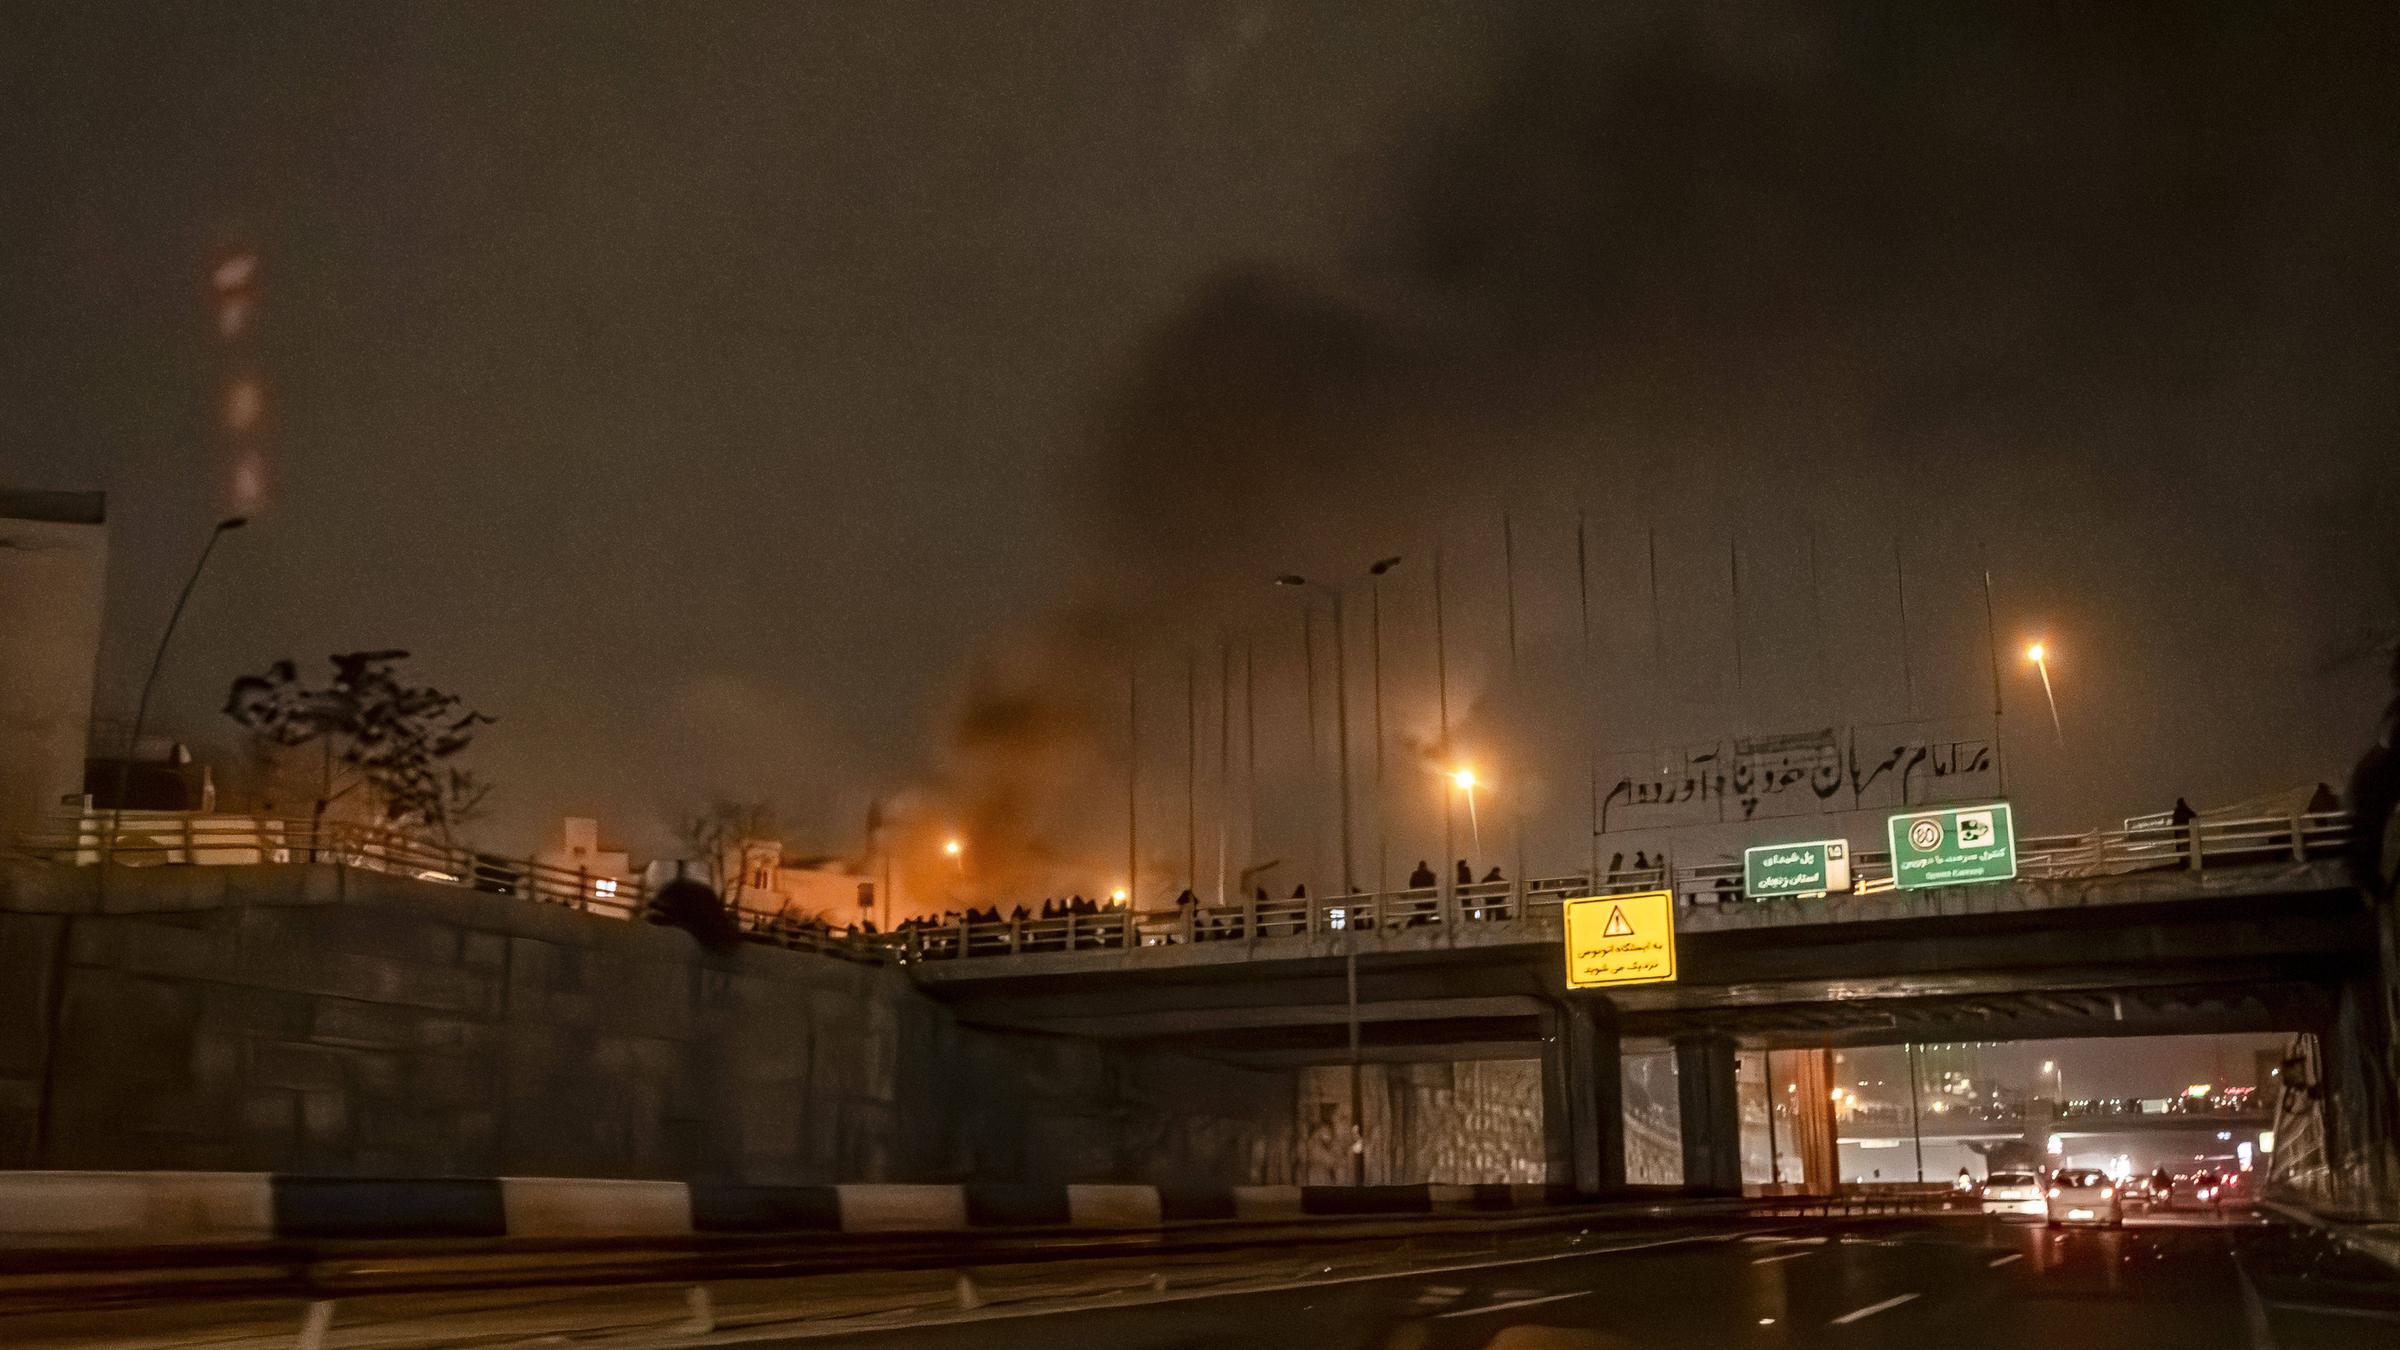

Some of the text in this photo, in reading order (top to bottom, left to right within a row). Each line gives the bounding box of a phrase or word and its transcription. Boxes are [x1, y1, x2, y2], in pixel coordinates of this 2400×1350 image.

[1762, 850, 1815, 868] پل شهدای
[1945, 853, 1978, 864] سرعت
[1979, 847, 2007, 862] کنترل
[1901, 857, 1934, 871] دوربین
[1757, 871, 1820, 889] استان زنجان
